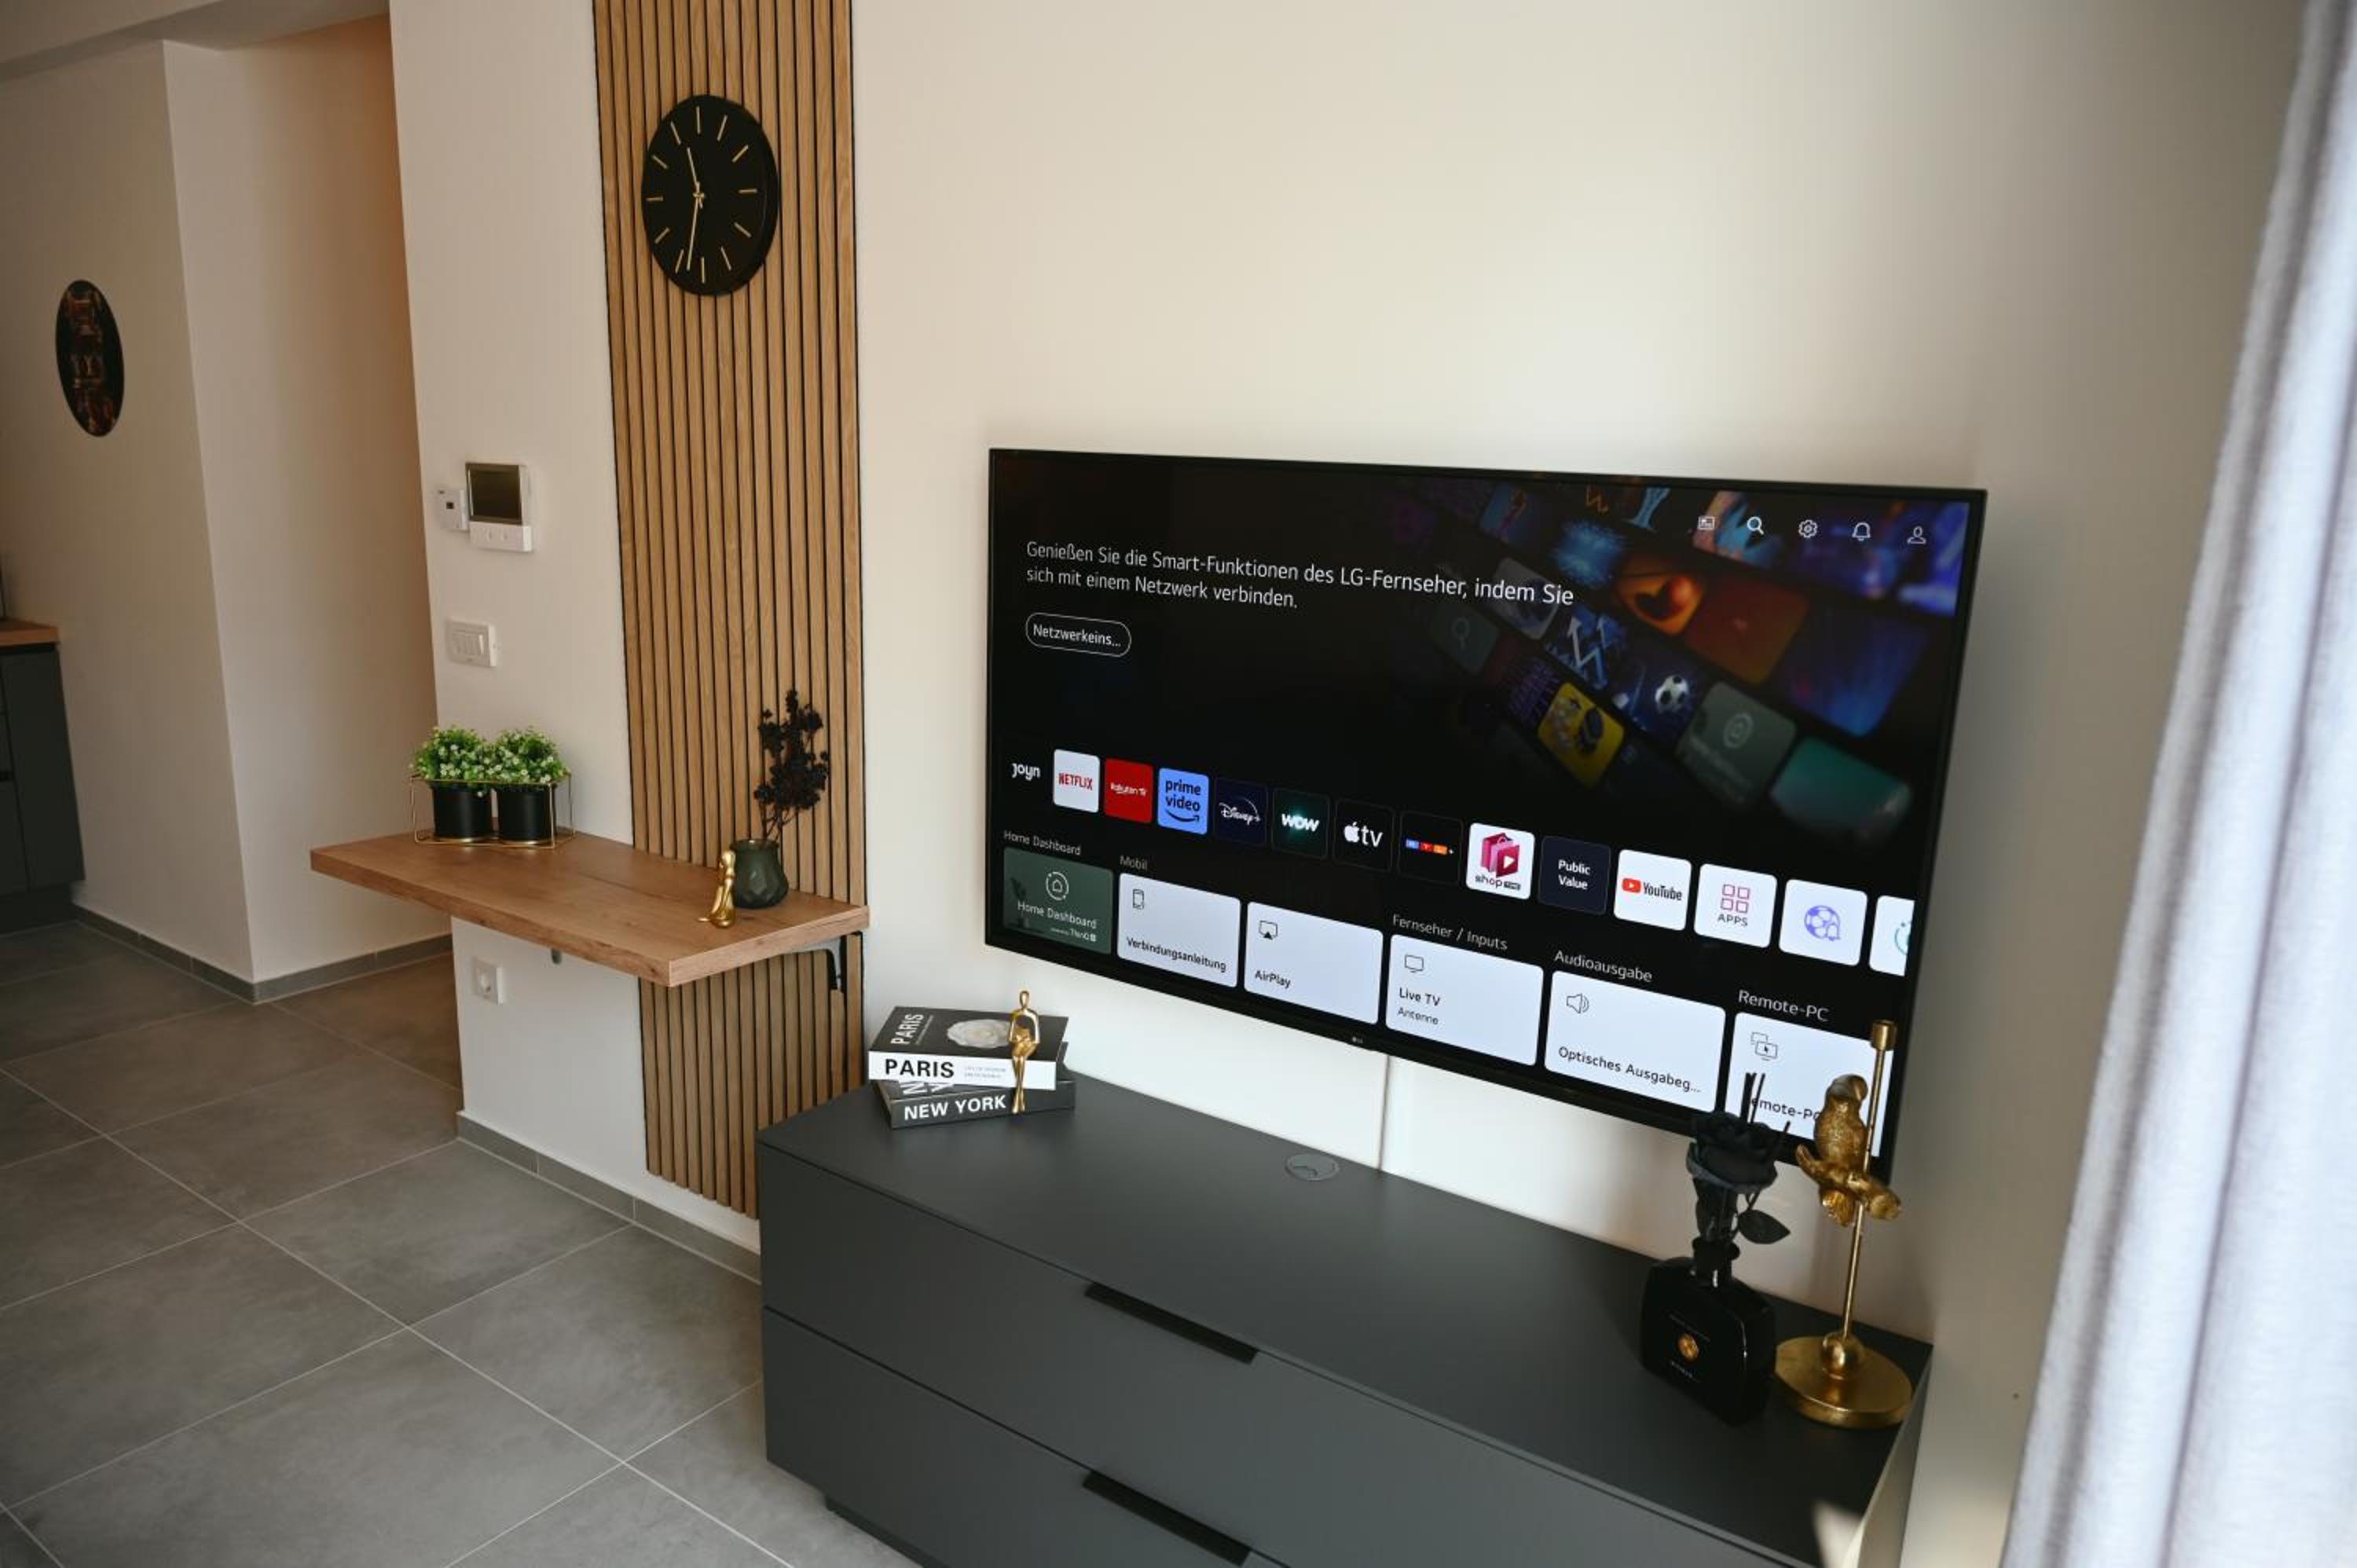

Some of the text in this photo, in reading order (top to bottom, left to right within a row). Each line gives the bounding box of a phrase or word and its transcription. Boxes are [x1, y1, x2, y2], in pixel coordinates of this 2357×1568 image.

[1027, 540, 1574, 606] Genießen Sie die Smart-Funktionen des LG-Fernseher, indem Sie
[1026, 566, 1298, 609] sich mit einem Netzwerk verbinden.
[1032, 624, 1121, 647] Netzwerkeins...
[1058, 773, 1093, 791] NETFLIX
[1165, 779, 1201, 796] prime
[1165, 796, 1200, 811] video
[1003, 830, 1081, 856] Home Dashboard
[1360, 825, 1384, 848] tv
[1558, 859, 1591, 875] Public
[1558, 874, 1588, 890] Value
[1643, 881, 1683, 901] YouTube
[1017, 901, 1097, 929] Home Dashboard
[1717, 913, 1748, 927] APPS
[1392, 914, 1508, 951] Fernseher / Inputs
[1126, 936, 1226, 973] Verbindungsanleitung
[1255, 969, 1291, 988] AirPlay
[1554, 950, 1652, 984] Audioausgabe
[1399, 987, 1441, 1006] Live TV
[1738, 989, 1830, 1022] Remote-PC
[890, 1013, 924, 1045] PARIS
[885, 1058, 955, 1079] PARIS
[1558, 1046, 1622, 1073] Optisches
[904, 1094, 1006, 1121] NEW YORK
[1750, 1097, 1822, 1120] emote-P
